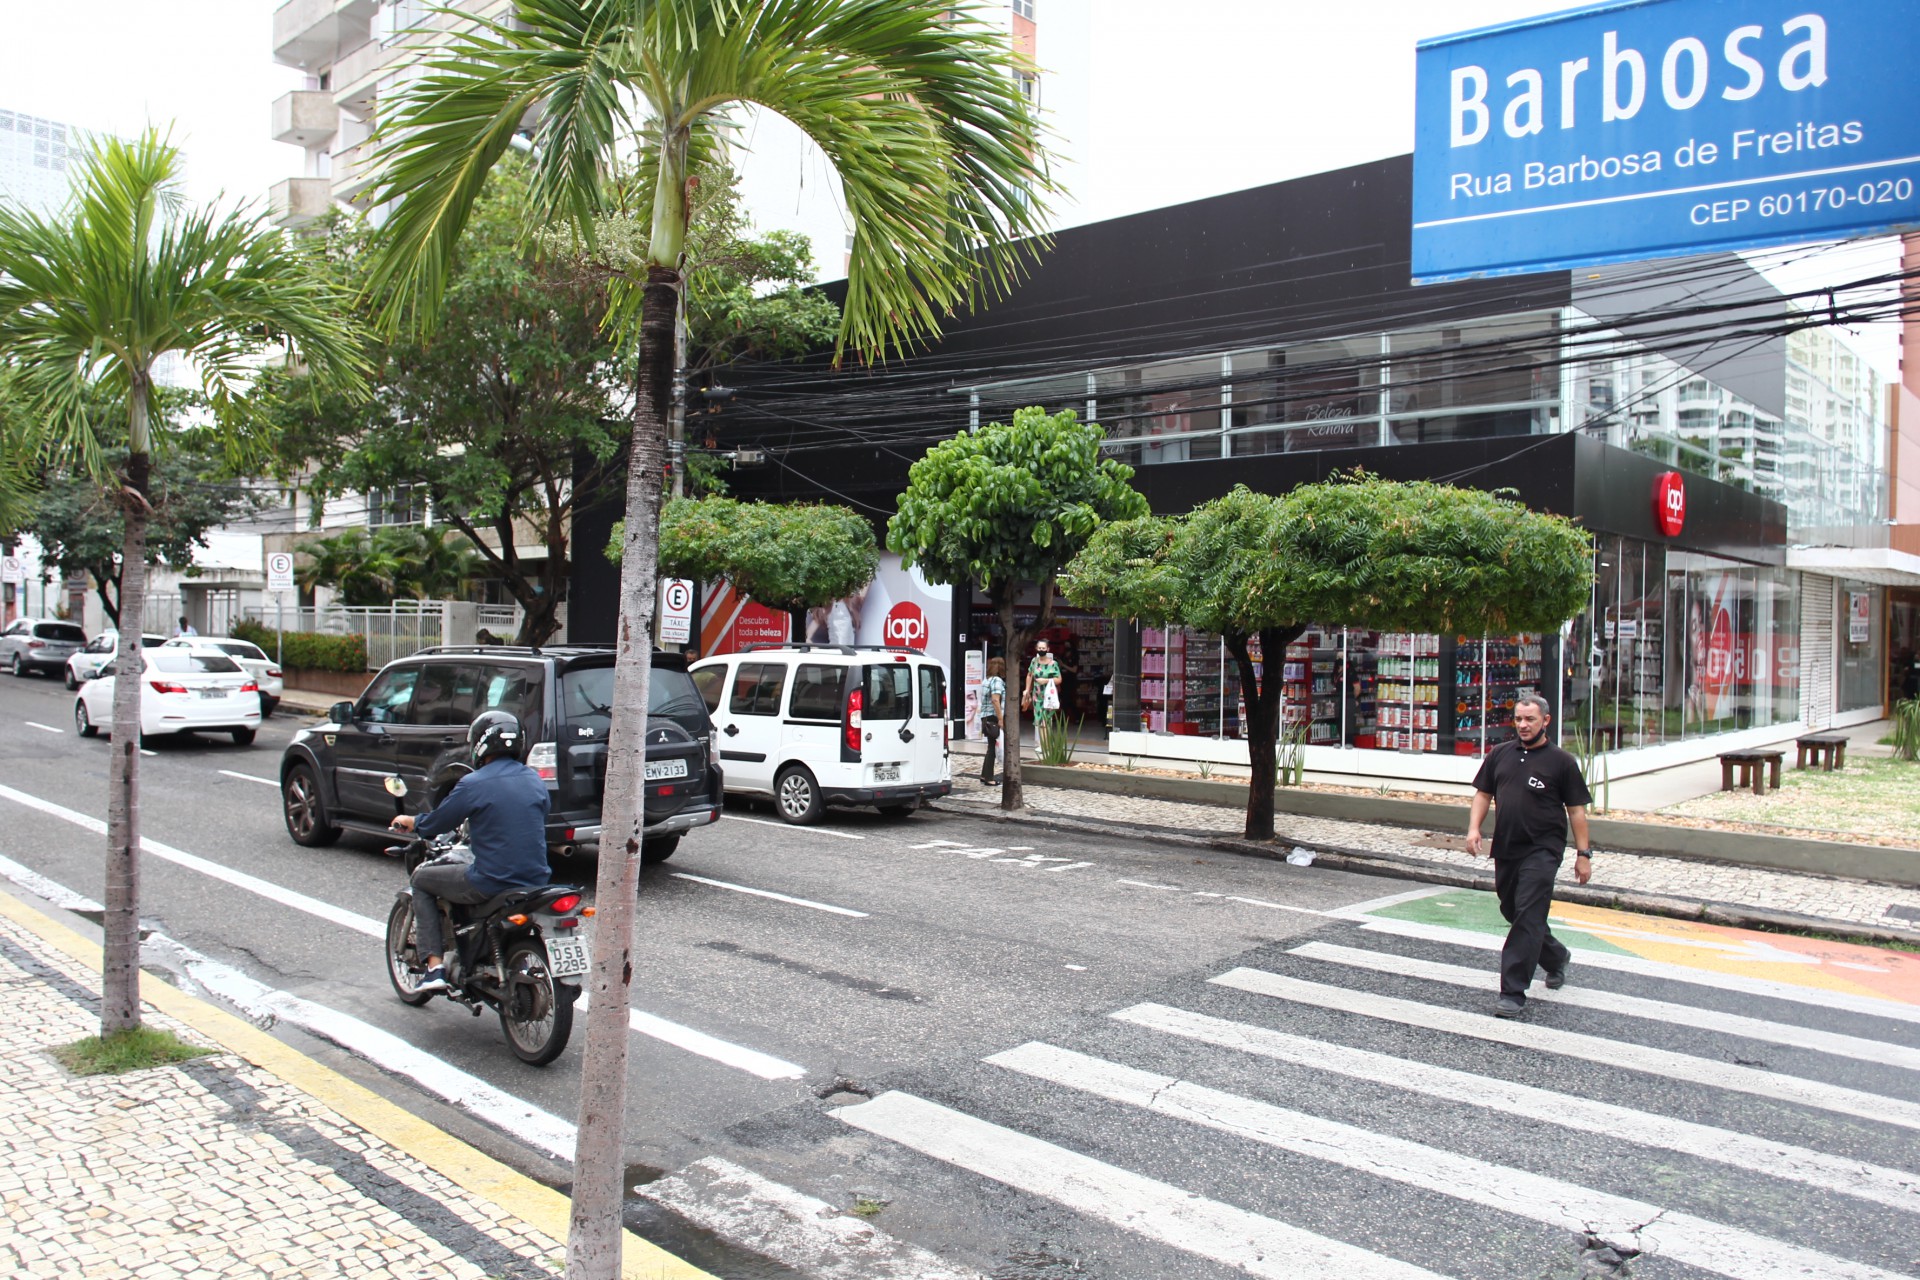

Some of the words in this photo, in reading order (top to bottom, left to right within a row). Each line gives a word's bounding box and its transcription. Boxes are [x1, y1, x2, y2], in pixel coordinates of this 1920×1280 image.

[1449, 13, 1829, 149] Barbosa
[1450, 172, 1512, 200] Rua
[1524, 151, 1662, 189] Barbosa
[1674, 139, 1718, 168] de
[1732, 121, 1863, 160] Freitas
[1690, 199, 1750, 225] CEP
[1758, 178, 1913, 218] 60170-020
[1305, 402, 1352, 421] Beleza
[276, 558, 284, 570] E
[673, 589, 682, 605] E
[739, 616, 769, 625] Descubra
[738, 628, 753, 636] toda
[759, 627, 782, 637] beleza
[554, 957, 588, 974] 2295
